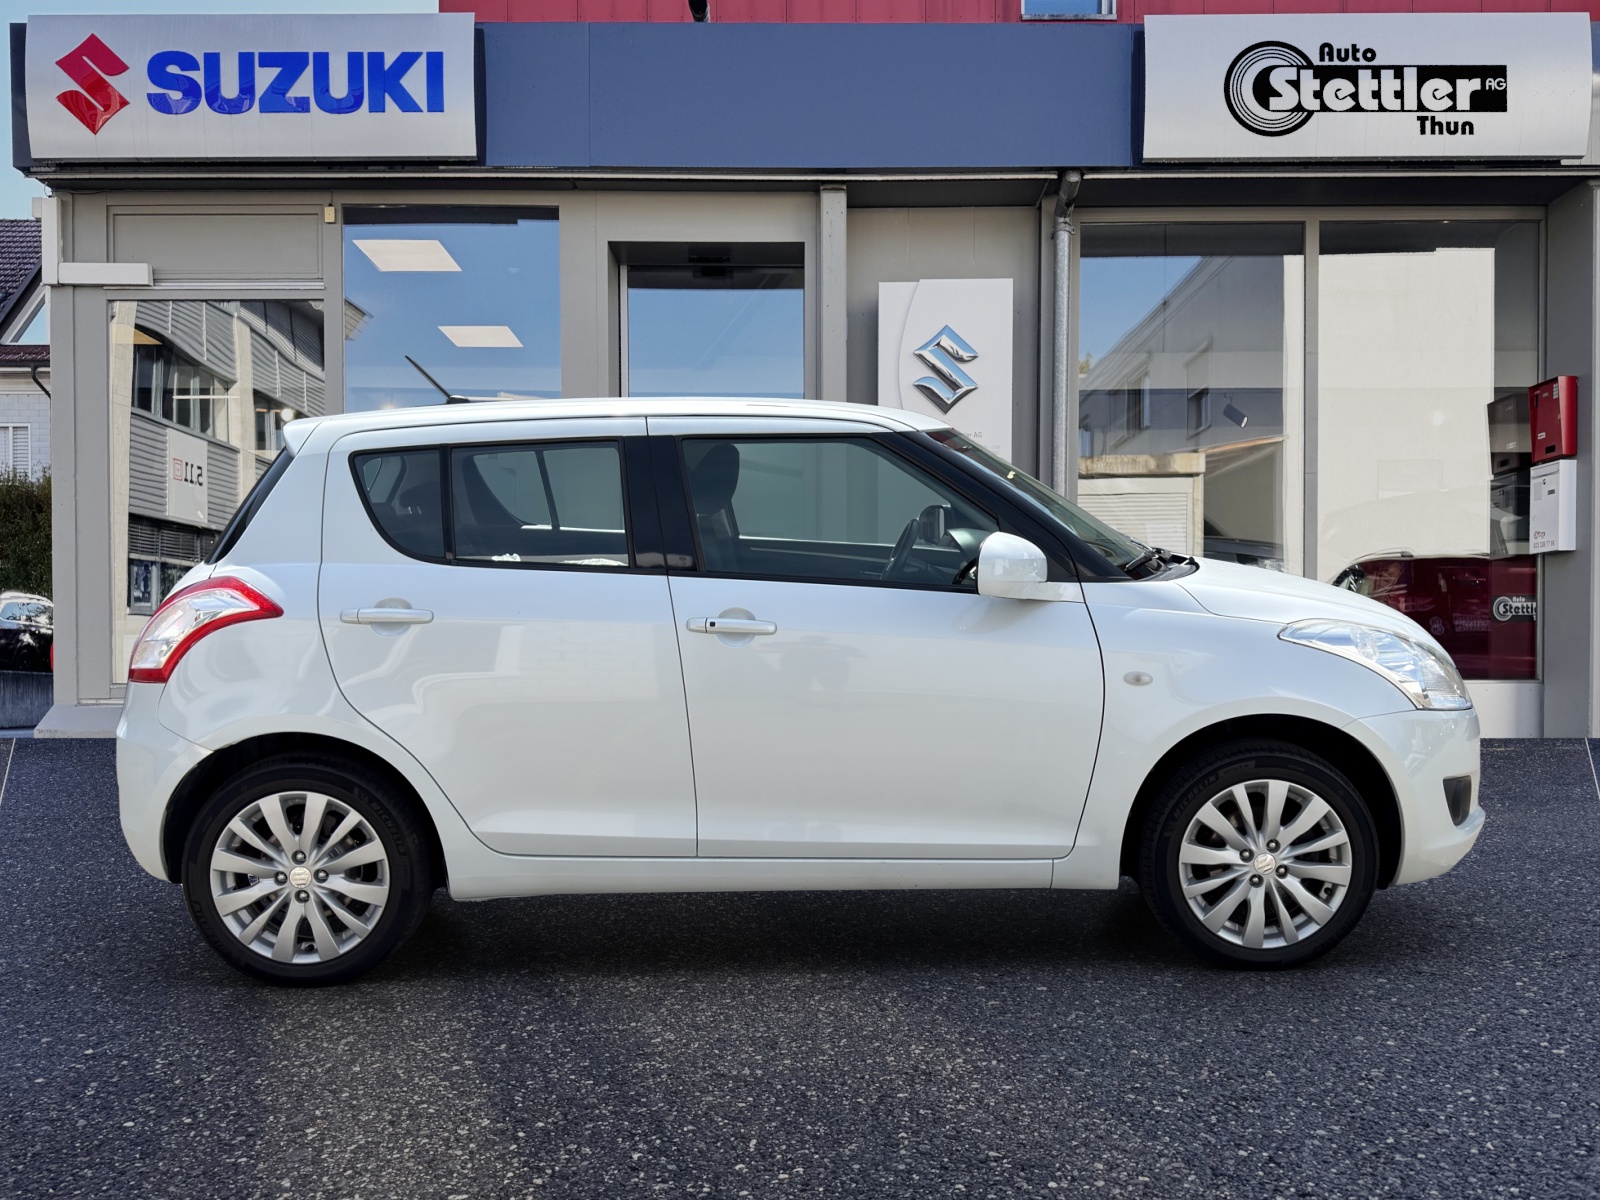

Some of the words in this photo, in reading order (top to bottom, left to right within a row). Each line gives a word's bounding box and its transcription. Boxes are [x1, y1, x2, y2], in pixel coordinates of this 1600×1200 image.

[1318, 42, 1376, 62] Auto
[147, 50, 444, 114] SUZUKI
[1269, 66, 1481, 111] Stettler
[1485, 77, 1506, 91] AG
[1416, 115, 1474, 135] Thun
[1173, 773, 1217, 820] MICHELIN
